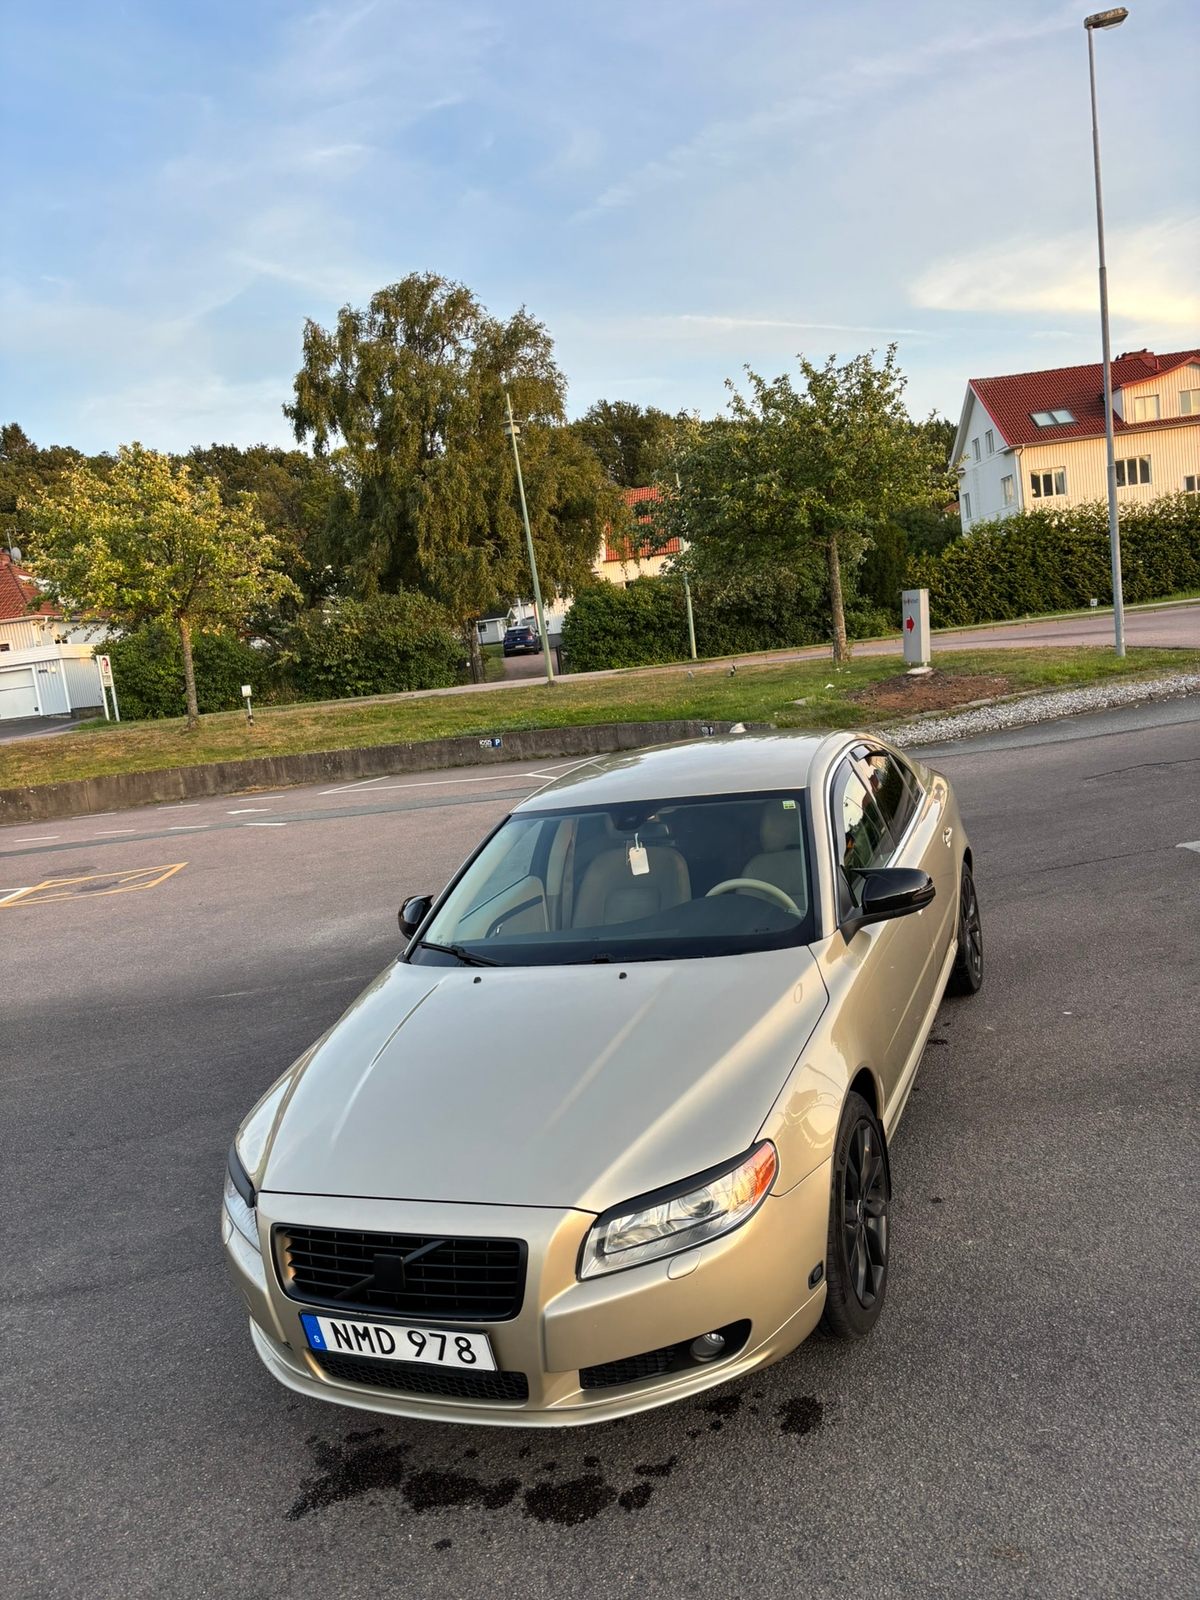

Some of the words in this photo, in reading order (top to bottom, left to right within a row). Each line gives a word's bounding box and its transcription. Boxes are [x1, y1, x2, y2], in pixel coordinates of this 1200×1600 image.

[495, 738, 500, 746] P
[314, 1335, 321, 1343] S
[329, 1321, 396, 1355] NMD
[407, 1329, 477, 1364] 978
